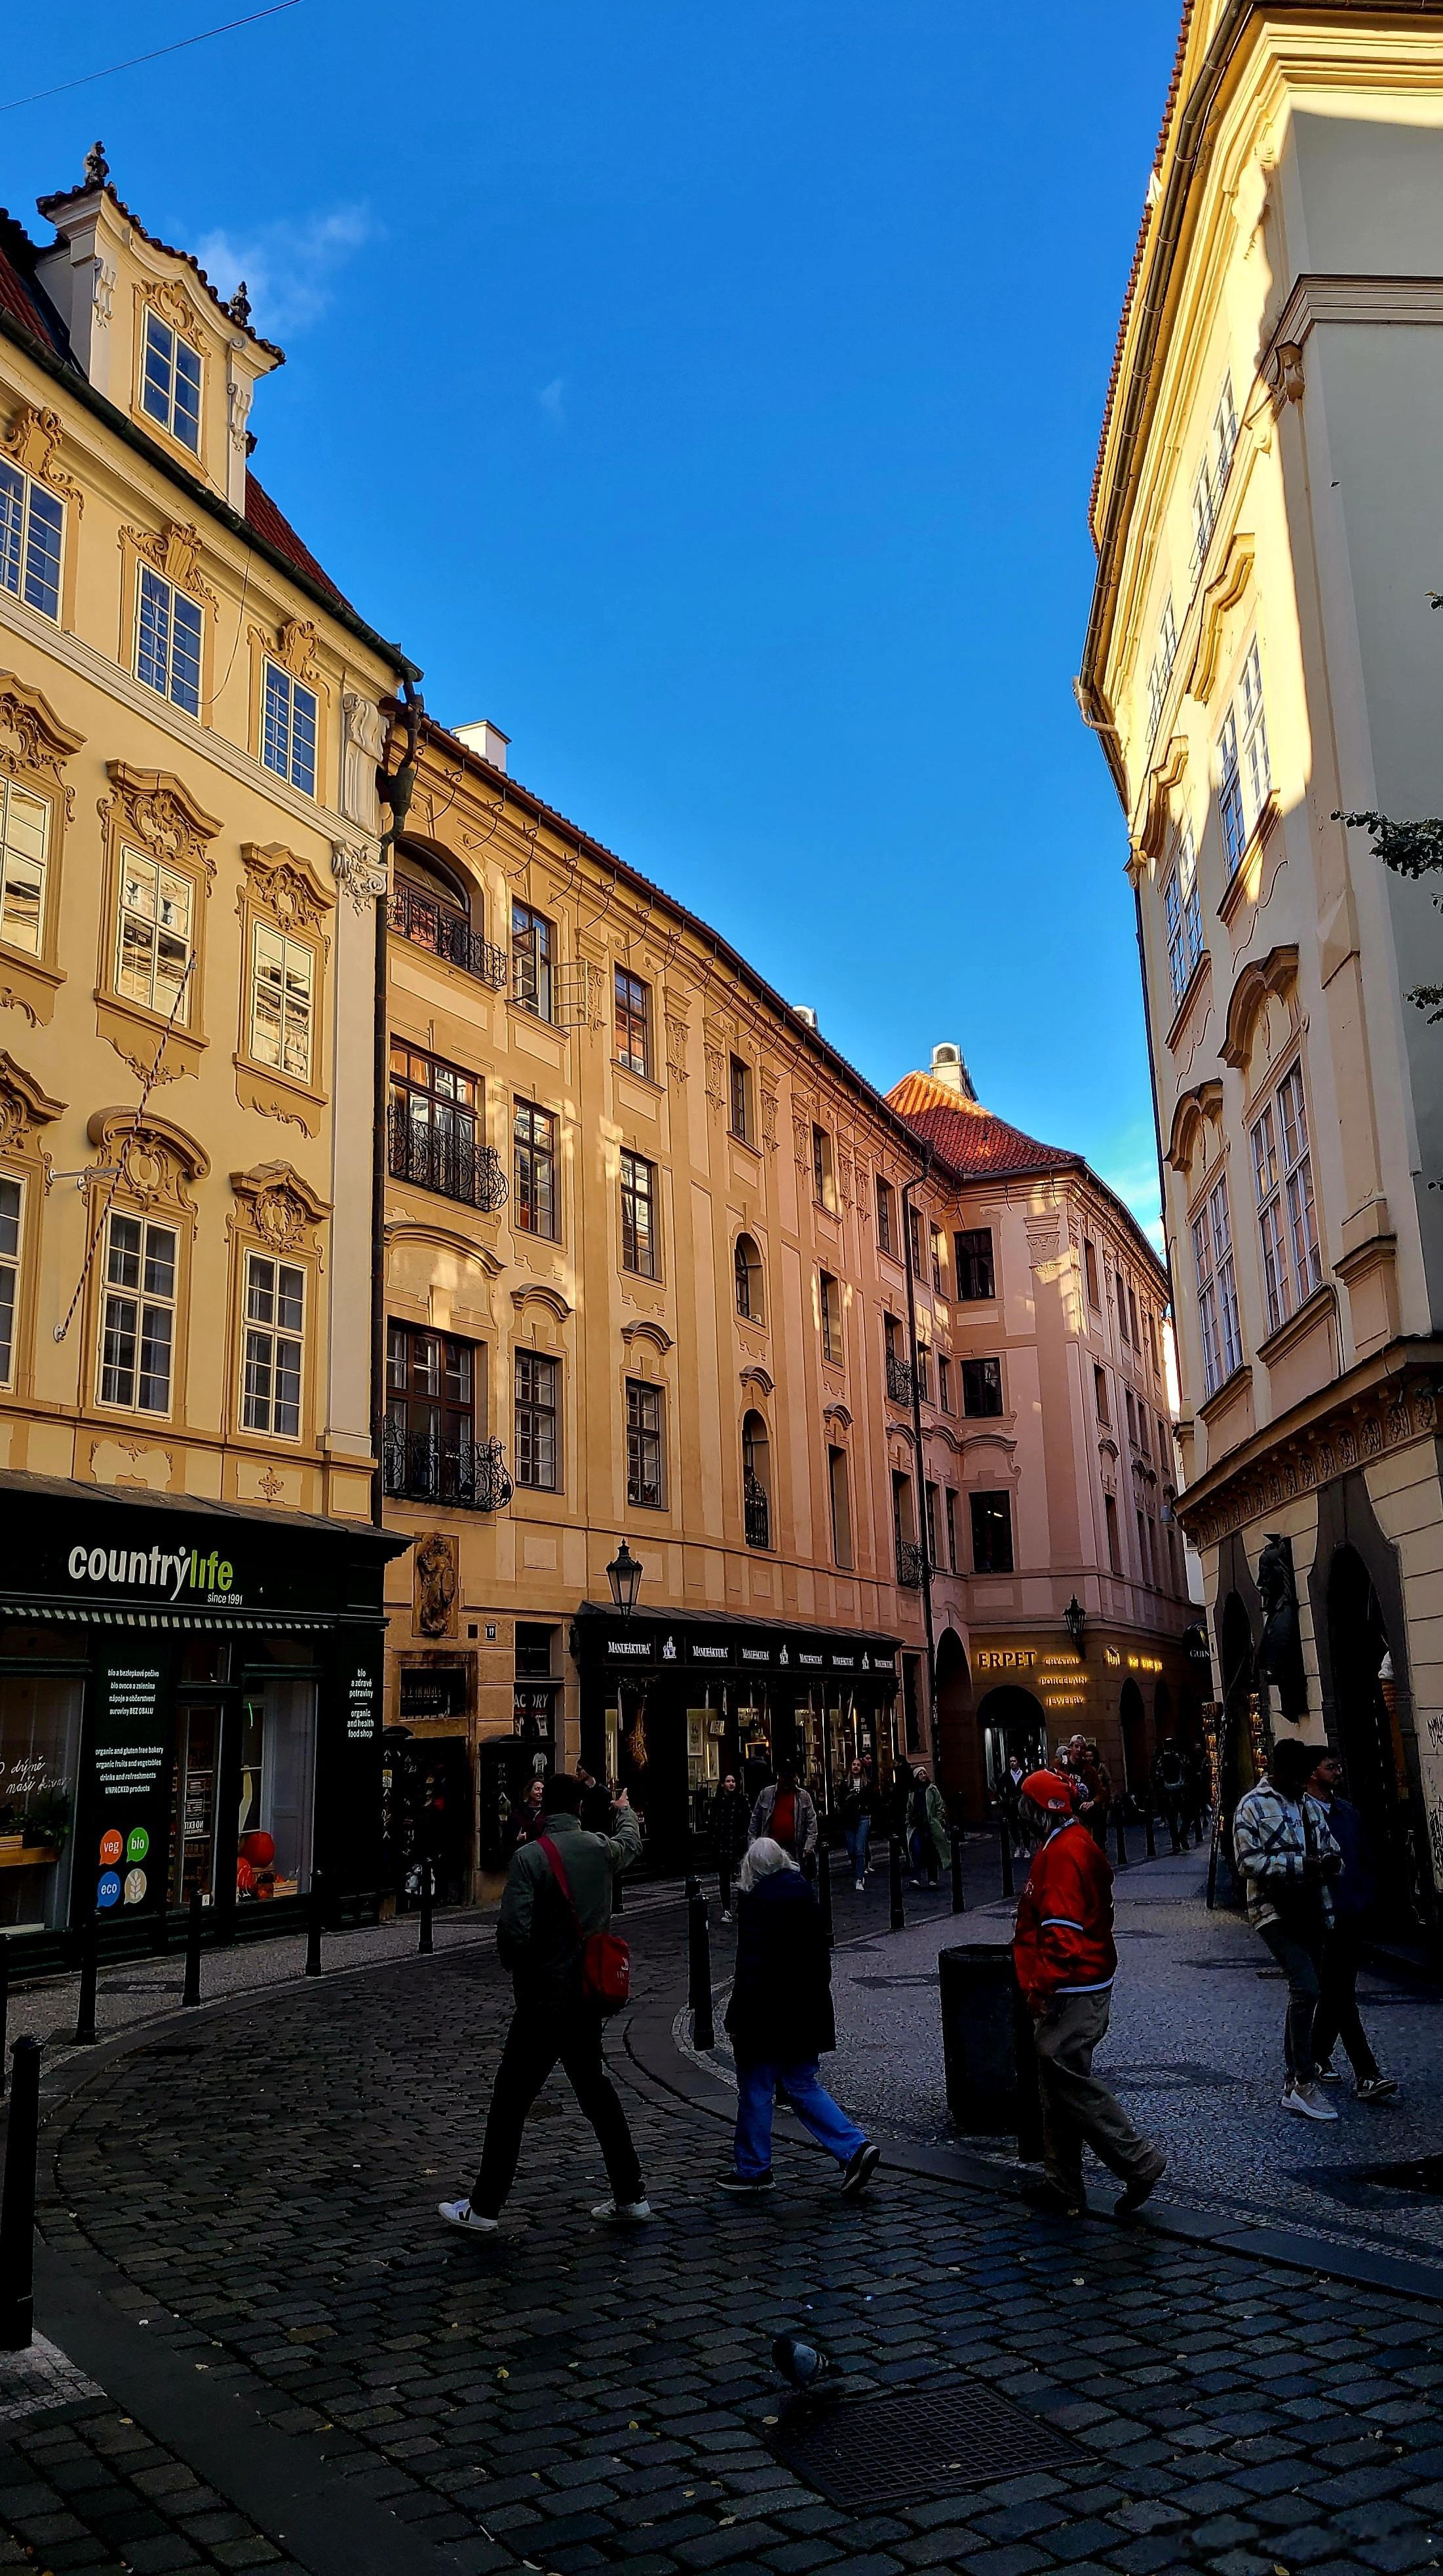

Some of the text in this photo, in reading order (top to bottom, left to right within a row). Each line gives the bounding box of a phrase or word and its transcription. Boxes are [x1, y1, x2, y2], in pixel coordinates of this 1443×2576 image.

[207, 1592, 242, 1605] since 1991
[607, 1641, 651, 1655] MANUFAKTURA
[692, 1645, 729, 1657] MANUFAKTURA
[978, 1651, 1037, 1668] ERPET
[1045, 1657, 1080, 1666] CRYSTAL
[145, 1670, 159, 1678] pečivo
[357, 1668, 366, 1677] bio
[355, 1678, 372, 1687] zdravé
[1039, 1676, 1087, 1685] PORCELAIN
[349, 1688, 374, 1699] potraviny
[514, 1693, 548, 1708] ACORY
[1047, 1697, 1085, 1706] JEWELRY
[109, 1707, 129, 1716] suroviny
[351, 1708, 371, 1719] organic
[347, 1719, 374, 1727] and health
[348, 1729, 373, 1739] food shop
[95, 1747, 113, 1756] organic
[123, 1747, 138, 1756] gluten
[96, 1760, 115, 1769] organic
[137, 1759, 162, 1767] vegetables
[105, 1785, 150, 1794] UNPACKED products
[104, 1841, 120, 1854] veg
[131, 1836, 145, 1850] bio
[101, 1883, 117, 1894] eco
